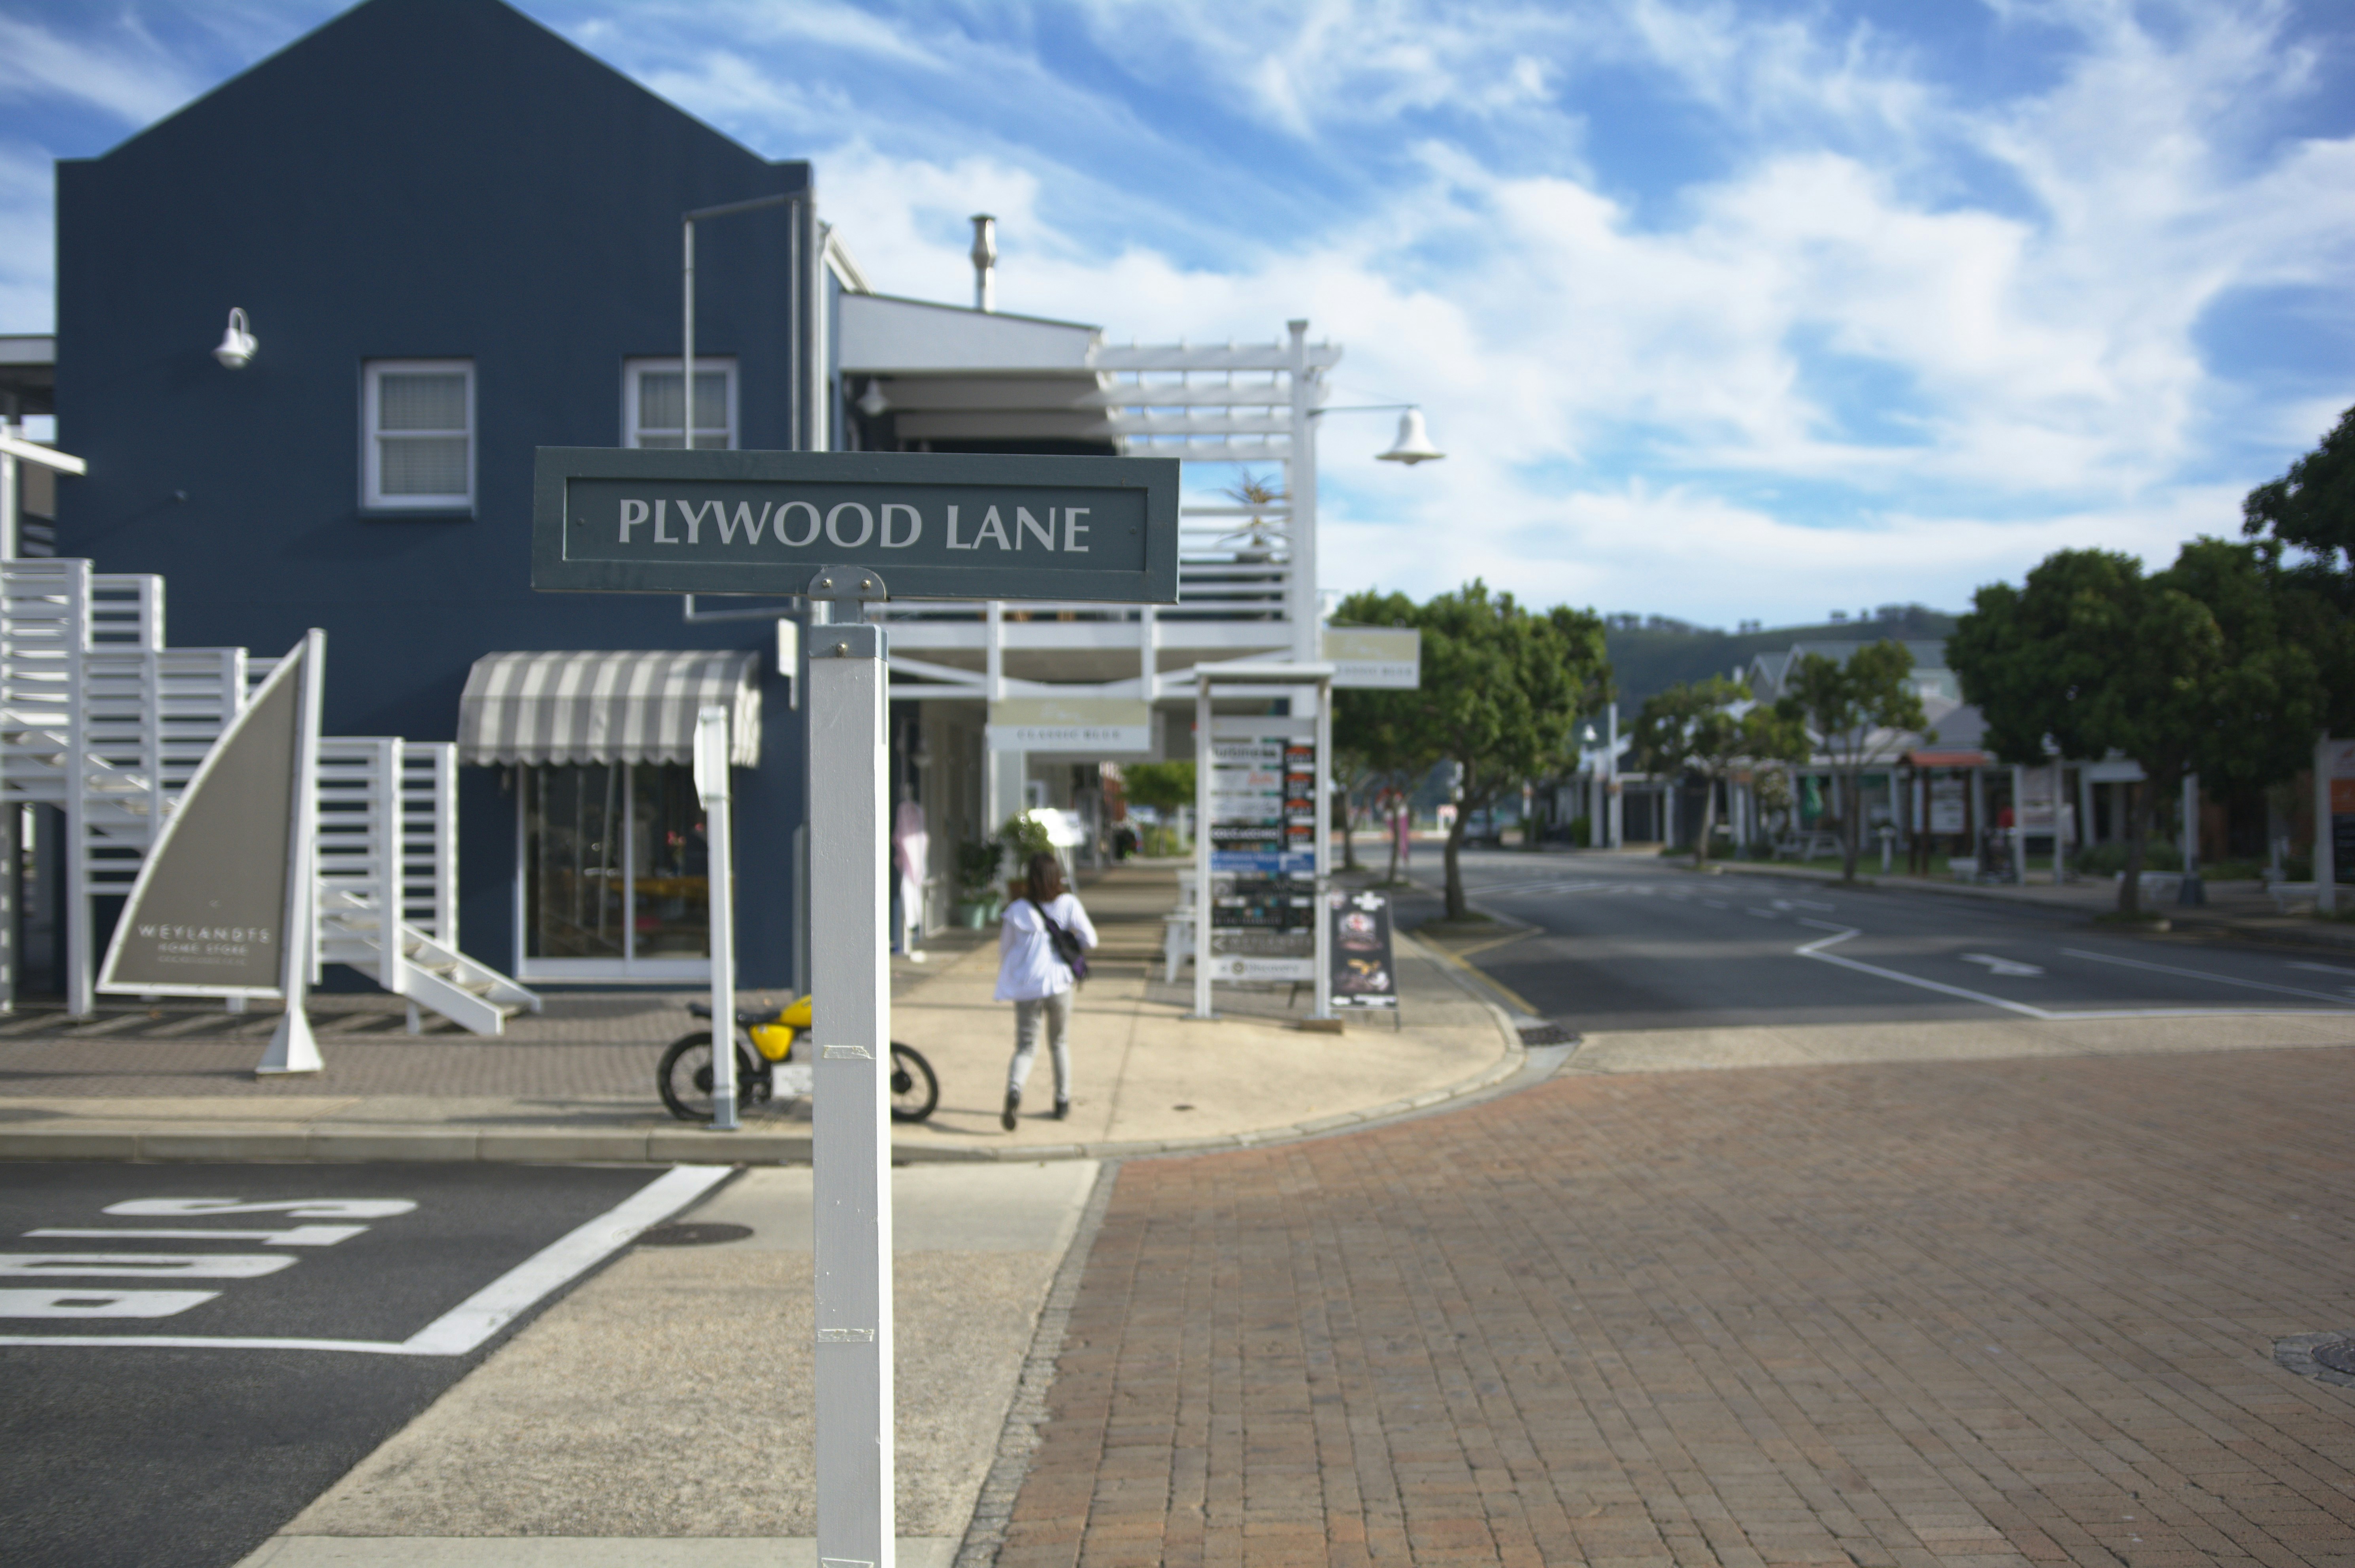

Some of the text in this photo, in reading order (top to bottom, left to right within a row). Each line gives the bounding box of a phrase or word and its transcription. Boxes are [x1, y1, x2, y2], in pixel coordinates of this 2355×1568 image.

[619, 498, 1090, 553] PLYWOOD LANE
[137, 923, 271, 944] WEYLANDTS
[158, 941, 249, 957] HOME STORE
